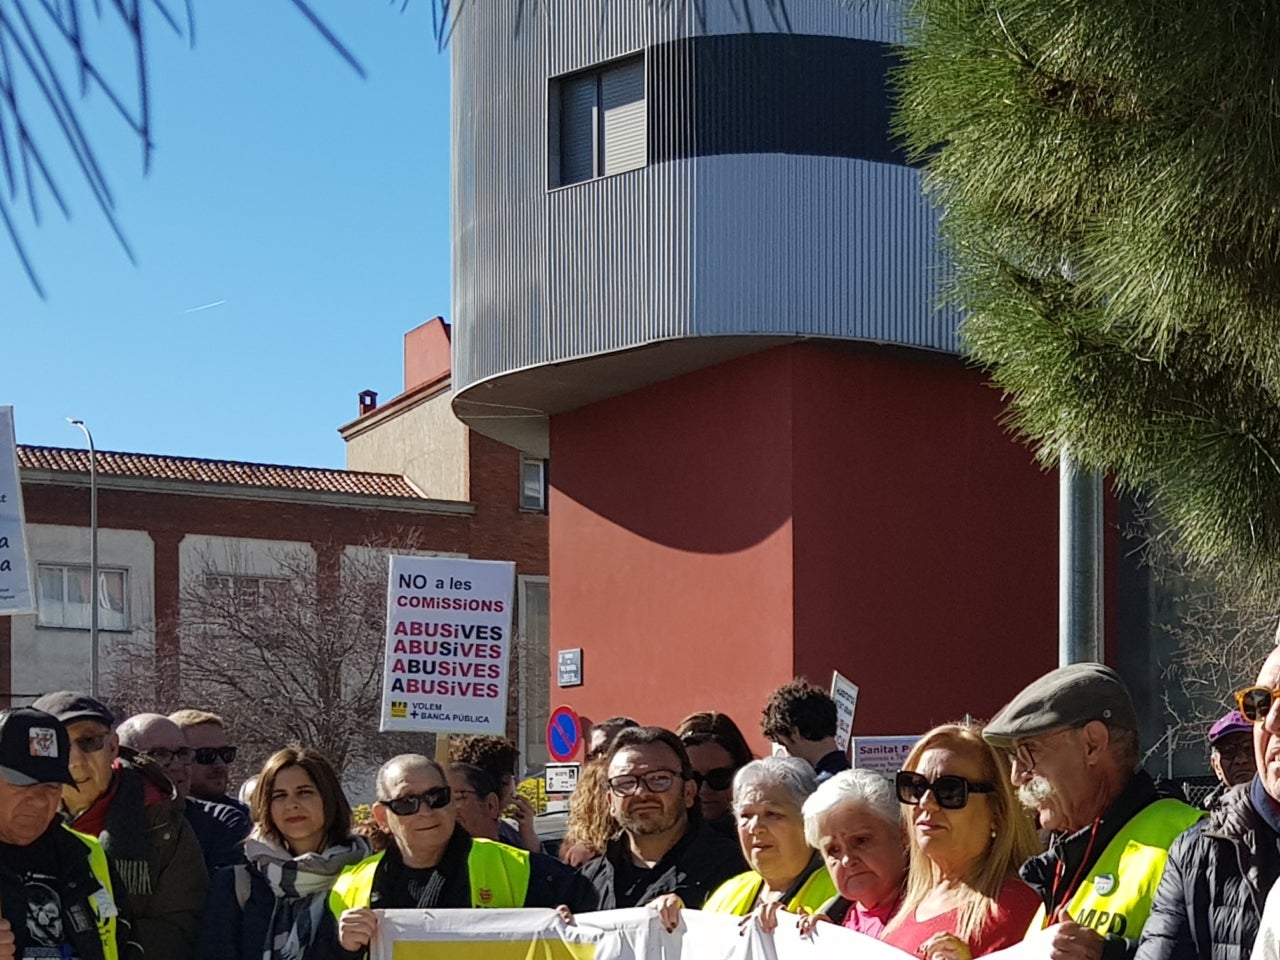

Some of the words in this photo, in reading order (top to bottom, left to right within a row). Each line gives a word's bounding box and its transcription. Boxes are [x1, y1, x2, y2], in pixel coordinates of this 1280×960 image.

[398, 573, 427, 590] NO
[435, 579, 444, 589] a
[449, 577, 472, 591] les
[412, 702, 442, 711] VOLEM
[420, 712, 451, 721] BANCA
[860, 745, 898, 754] Sanitat
[1076, 909, 1128, 937] MPD
